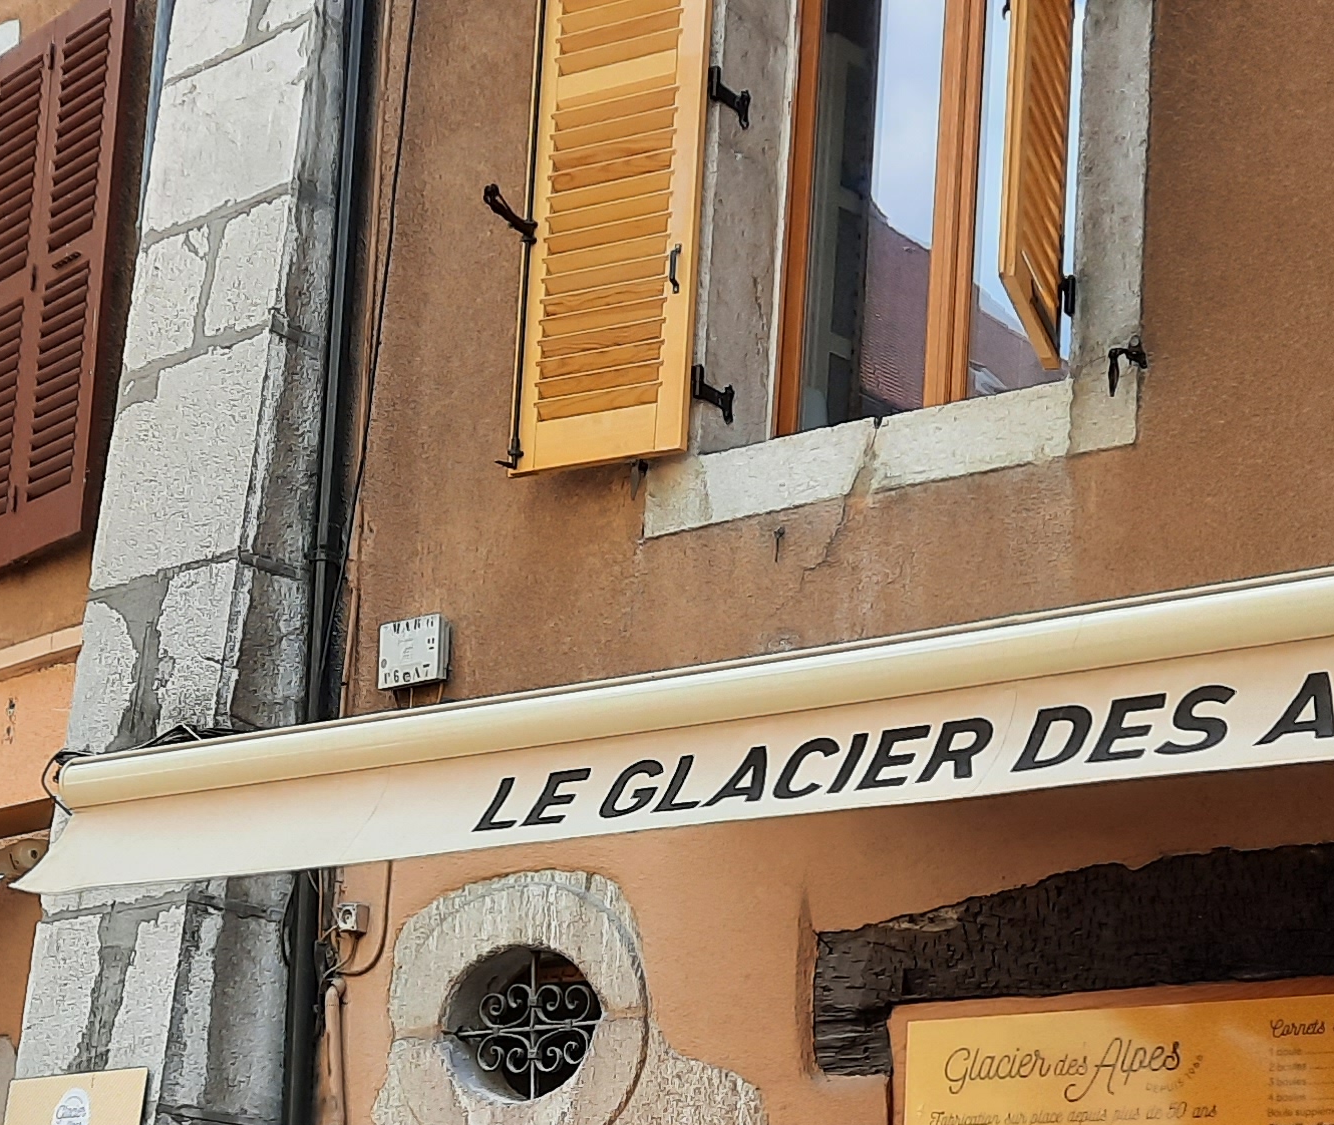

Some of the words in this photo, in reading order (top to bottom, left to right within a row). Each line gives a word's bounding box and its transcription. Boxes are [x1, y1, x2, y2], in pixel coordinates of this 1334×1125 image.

[472, 768, 591, 833] LE
[598, 717, 993, 818] GLACIER
[1010, 683, 1237, 772] DES
[1270, 1018, 1326, 1038] Cornets
[944, 1047, 1051, 1095] Glacier
[1054, 1054, 1088, 1077] des
[1064, 1036, 1181, 1103] Alpes
[1004, 1112, 1027, 1125] sur
[1192, 1104, 1217, 1119] ans
